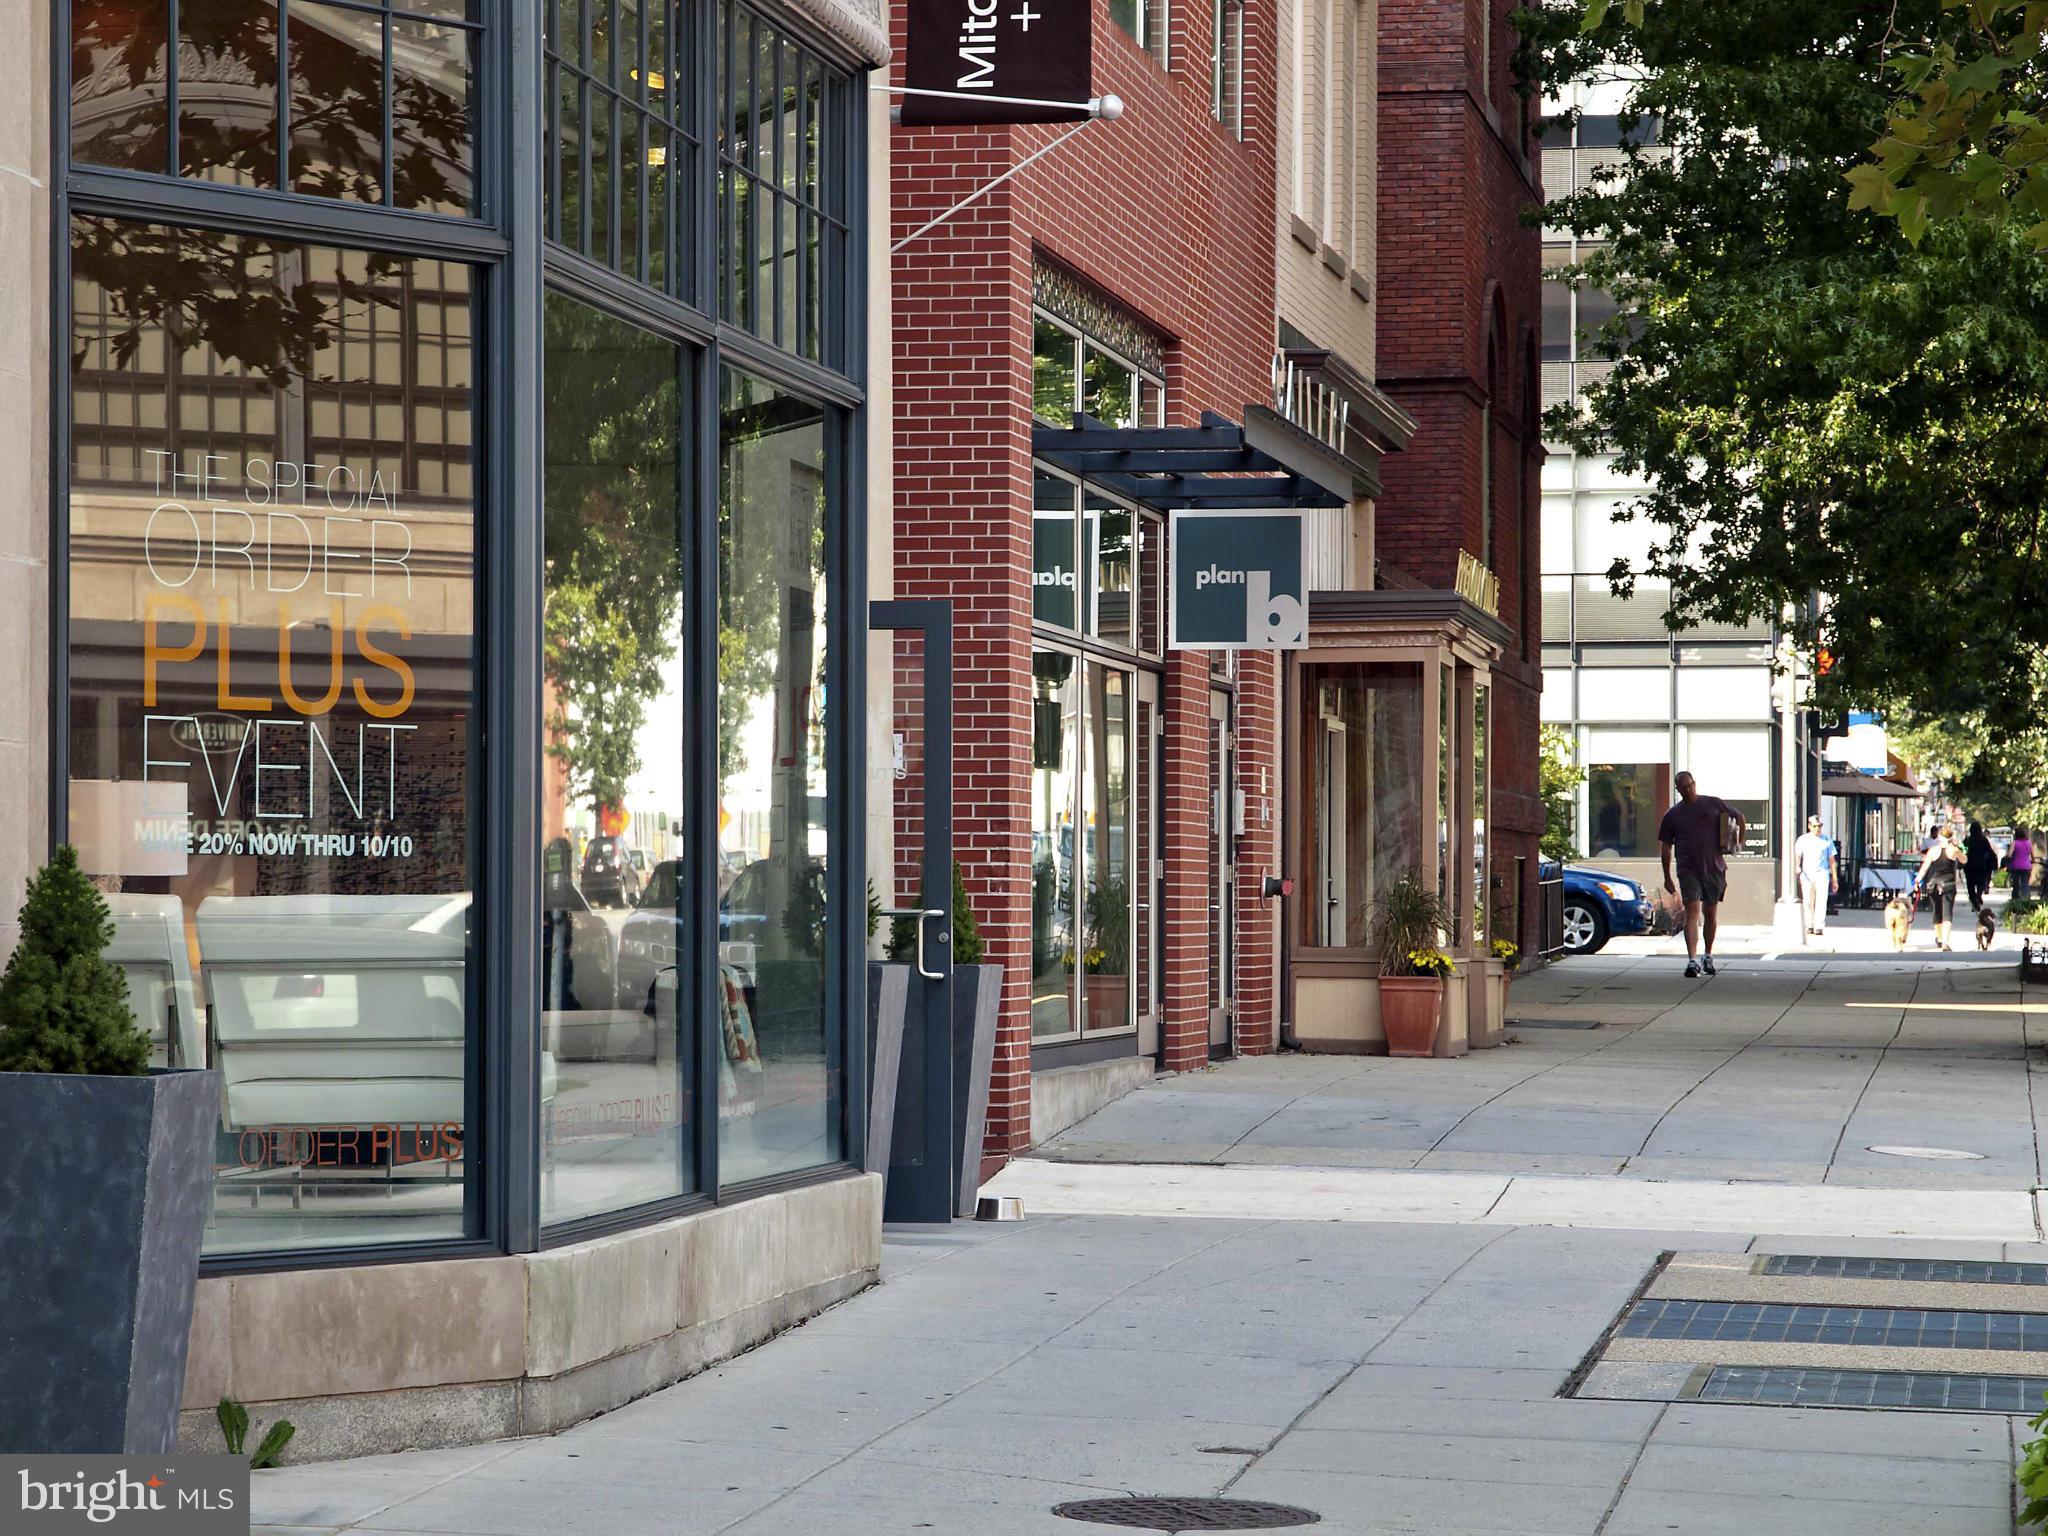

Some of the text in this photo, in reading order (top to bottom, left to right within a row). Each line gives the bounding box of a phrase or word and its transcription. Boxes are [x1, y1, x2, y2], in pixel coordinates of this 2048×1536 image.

[145, 449, 412, 517] THE SPECIAL
[145, 502, 411, 600] ORDER
[1196, 564, 1245, 590] plan
[1246, 570, 1301, 644] b
[143, 593, 416, 718] PLUS
[143, 714, 418, 821] EVENT
[199, 832, 244, 855] 20%
[249, 833, 297, 856] NOW
[301, 834, 355, 857] THRU
[360, 835, 413, 857] 10/10
[239, 1121, 463, 1169] ORDER PLUS
